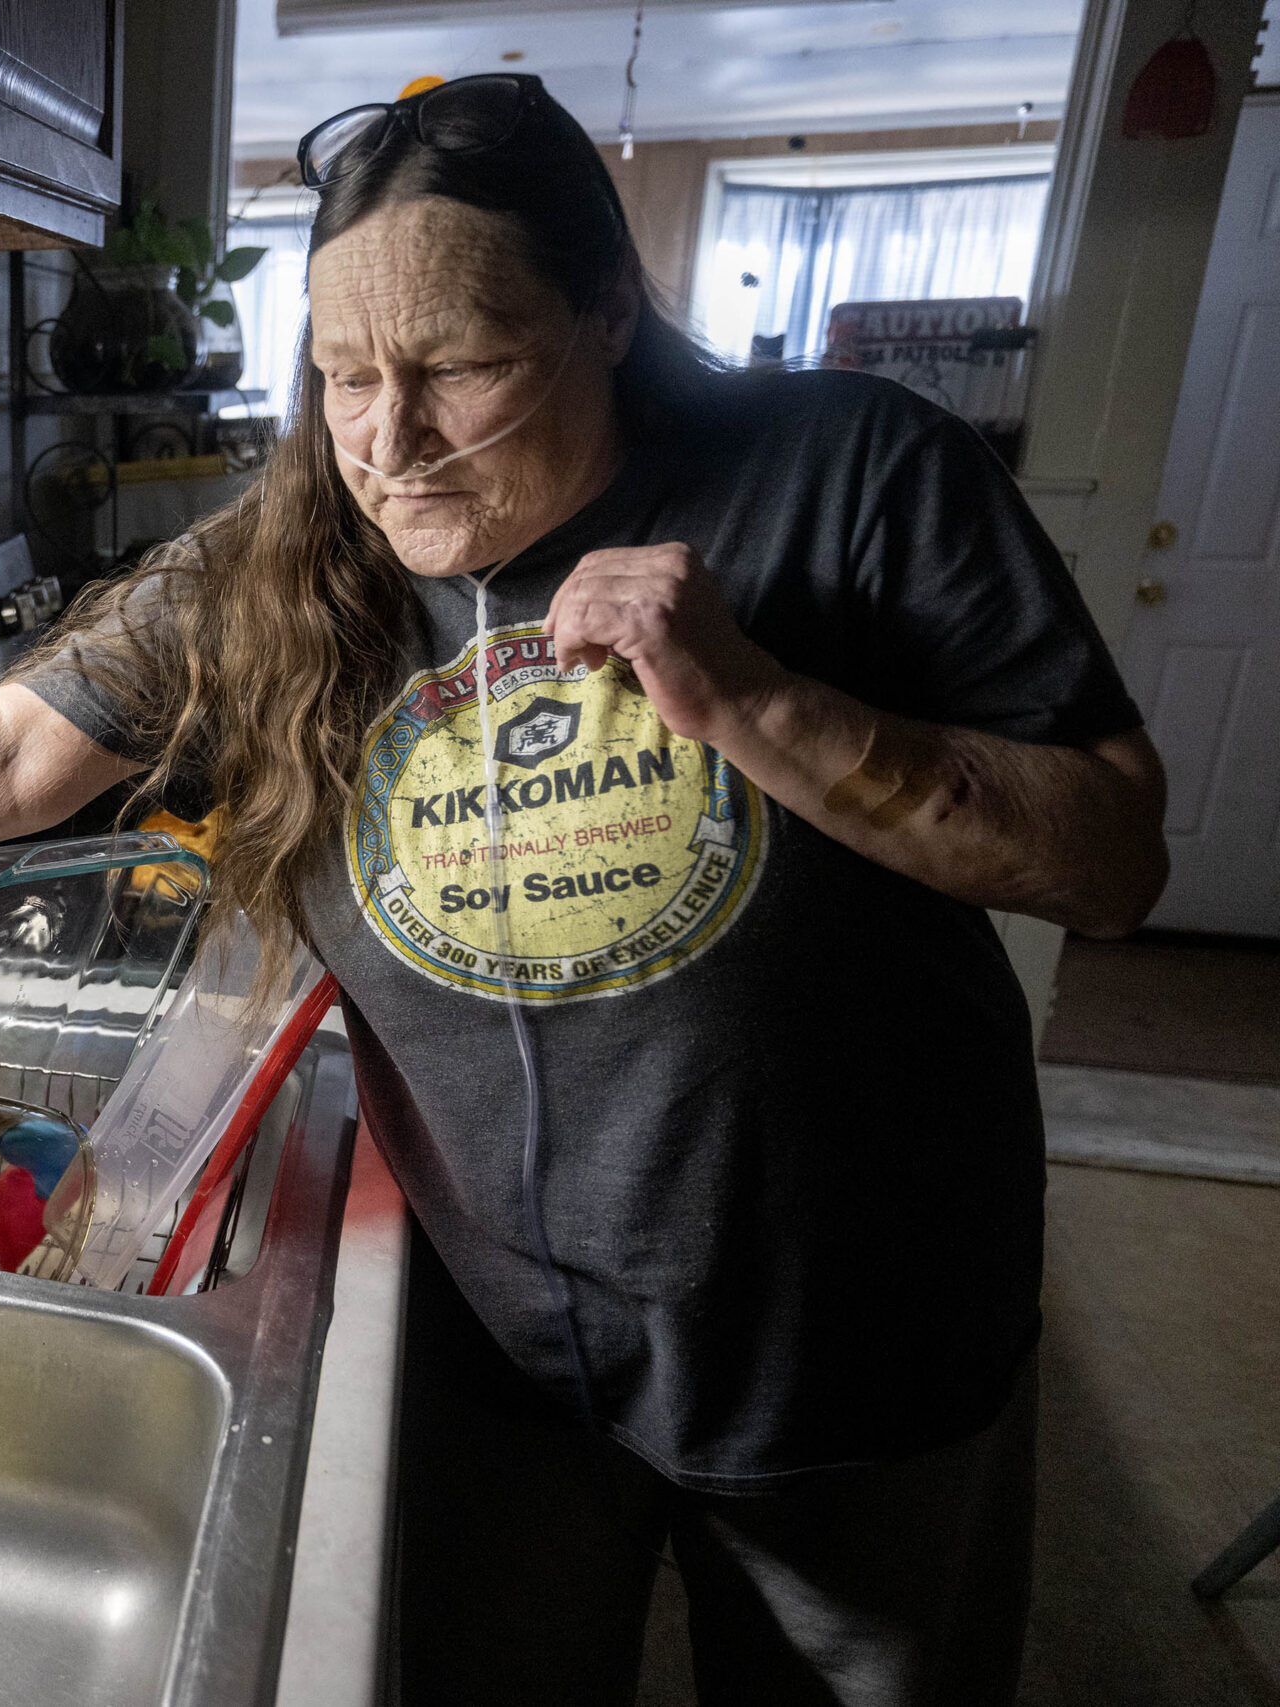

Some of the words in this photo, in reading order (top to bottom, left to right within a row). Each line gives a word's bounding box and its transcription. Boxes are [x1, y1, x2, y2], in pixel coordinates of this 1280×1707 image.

[411, 747, 675, 828] KIKKOMAN
[422, 833, 567, 870] TRADITONALLY
[575, 814, 672, 847] BREWED
[388, 898, 435, 949] OVER
[436, 941, 478, 968] 300
[572, 954, 607, 978] OF
[607, 852, 731, 966] EXCELLENCE
[440, 884, 510, 914] Soy
[523, 862, 661, 903] Sauce
